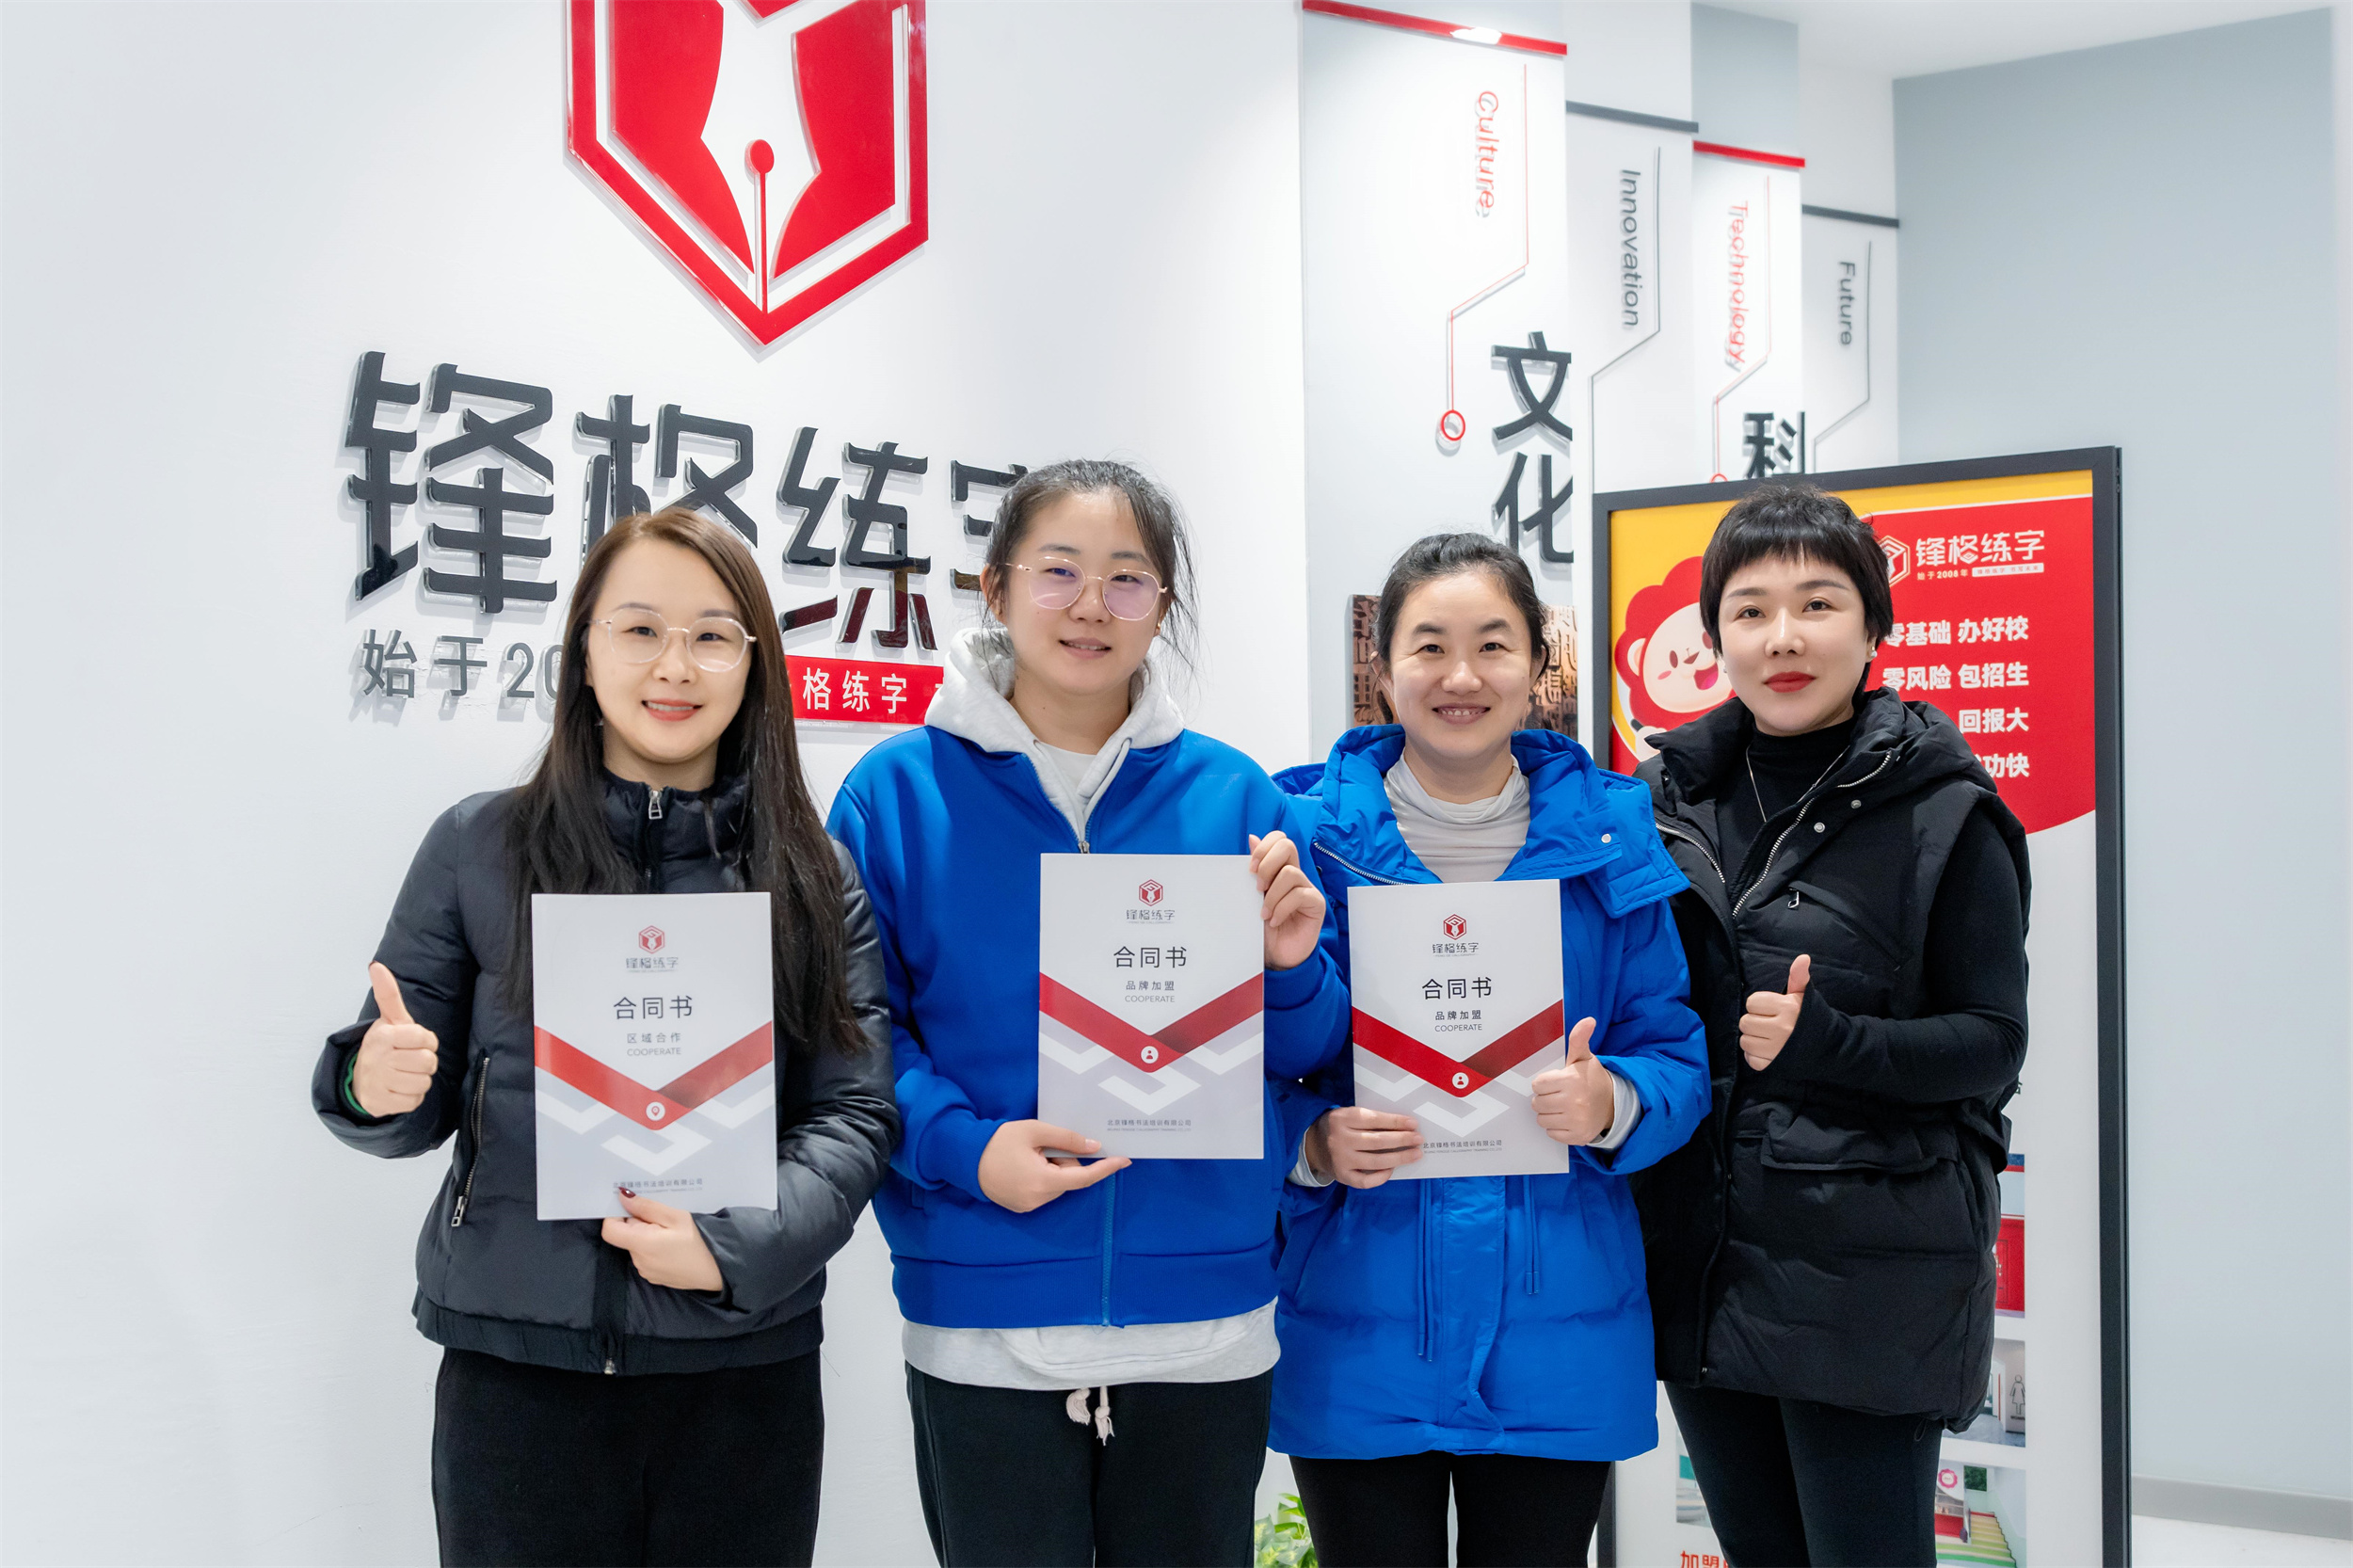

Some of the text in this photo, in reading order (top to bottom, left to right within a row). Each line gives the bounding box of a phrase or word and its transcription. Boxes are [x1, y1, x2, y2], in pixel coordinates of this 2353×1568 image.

[1478, 90, 1499, 208] Culture
[1621, 168, 1642, 327] Innovation
[1728, 200, 1749, 363] Technology
[1839, 262, 1855, 345] Future
[1491, 331, 1574, 563] 文化
[1916, 530, 2045, 567] 锋格练字
[1886, 616, 2028, 648] 零基础 办好校
[1882, 662, 2029, 692] 零风险 包招生
[788, 667, 906, 714] 格练字
[1959, 707, 2029, 734] 回报大
[1974, 754, 2029, 778] 功快
[1126, 909, 1175, 921] 锋格练字
[1113, 946, 1187, 968] 合同书
[1433, 942, 1479, 953] 锋格练字
[1126, 981, 1175, 991] 品牌加盟
[1422, 977, 1492, 1000] 合同书
[614, 996, 693, 1019] 合同书
[1125, 995, 1175, 1003] COOPERATE
[1435, 1010, 1481, 1020] 品牌加盟
[627, 1032, 681, 1044] 区域合作
[1434, 1023, 1482, 1032] COOPERATE
[627, 1047, 681, 1056] COOPERATE
[1680, 1550, 1729, 1568] 加盟
